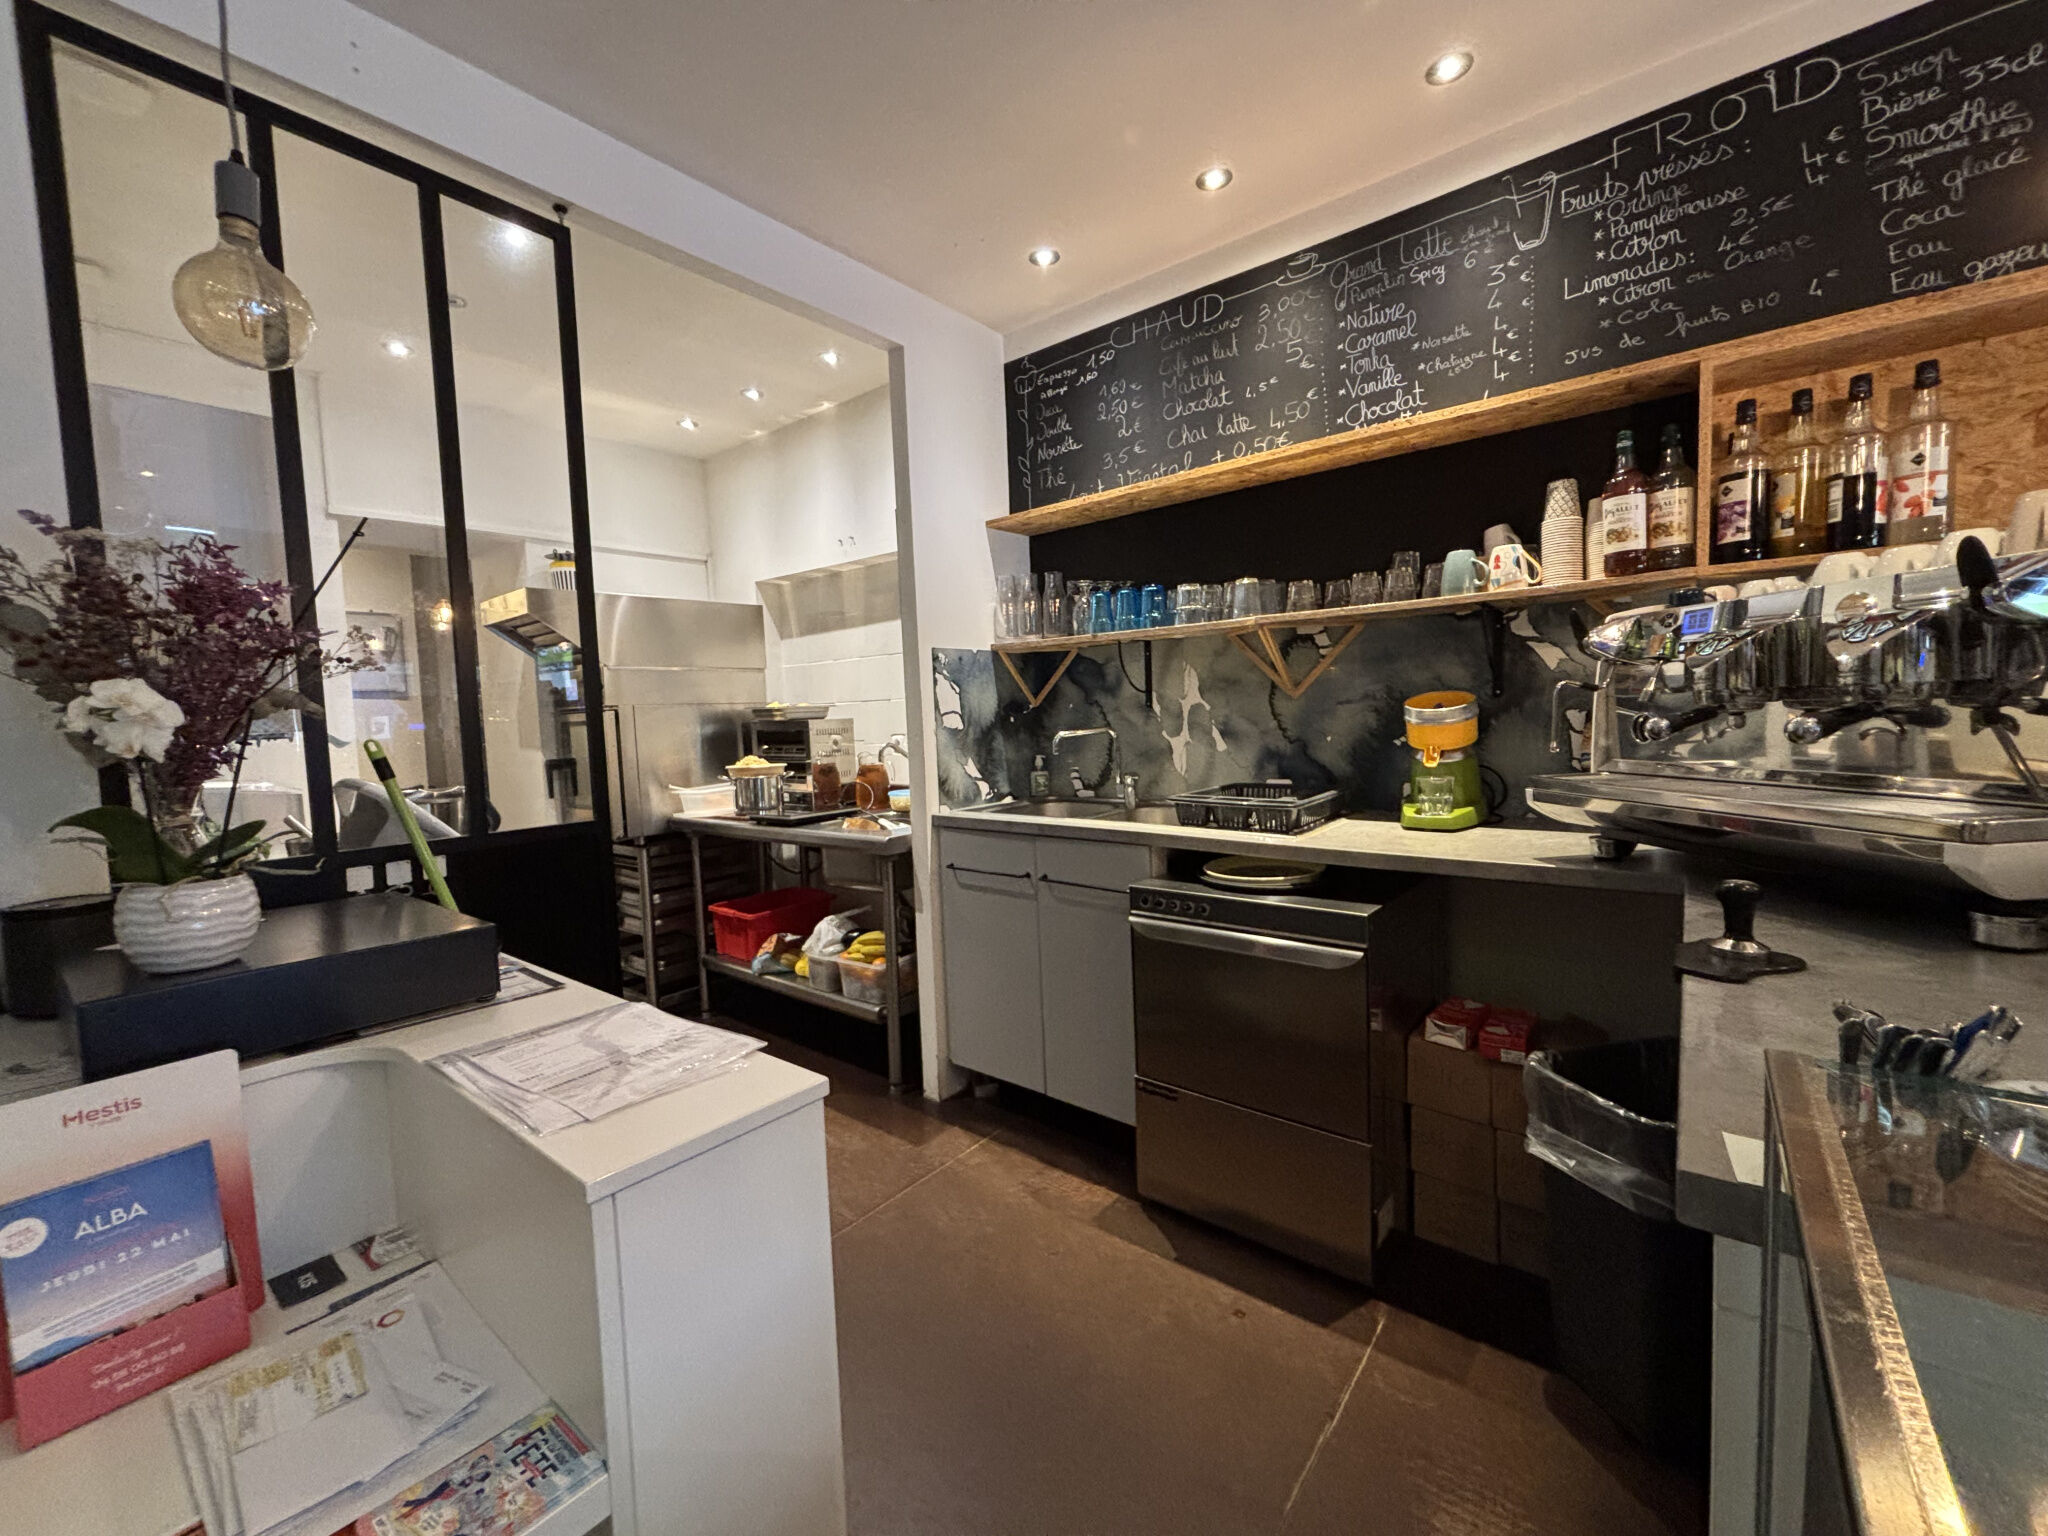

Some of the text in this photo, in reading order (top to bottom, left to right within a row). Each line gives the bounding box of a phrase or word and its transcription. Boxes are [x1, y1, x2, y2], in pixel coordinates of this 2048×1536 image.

[1857, 47, 1960, 97] Sirop
[1866, 96, 2031, 159] Smoothie
[1870, 171, 1929, 203] Thé
[1609, 187, 1750, 241] Pamplemousse
[1880, 205, 1966, 236] Coca
[1889, 238, 1955, 264] Eau
[1890, 266, 1952, 294] Eau
[1110, 294, 1224, 349] CHAUD
[1347, 302, 1407, 331] Nature
[1618, 299, 1683, 325] Cola
[1619, 332, 1646, 350] de
[1740, 291, 1781, 315] BIO
[1345, 310, 1418, 354] Caramel
[1345, 346, 1396, 375] Tonka
[1162, 366, 1226, 399] Matcha
[1346, 367, 1408, 399] Vanille
[1345, 380, 1428, 426] Chocolat
[1038, 467, 1067, 490] Thé
[74, 1202, 149, 1240] ALBA
